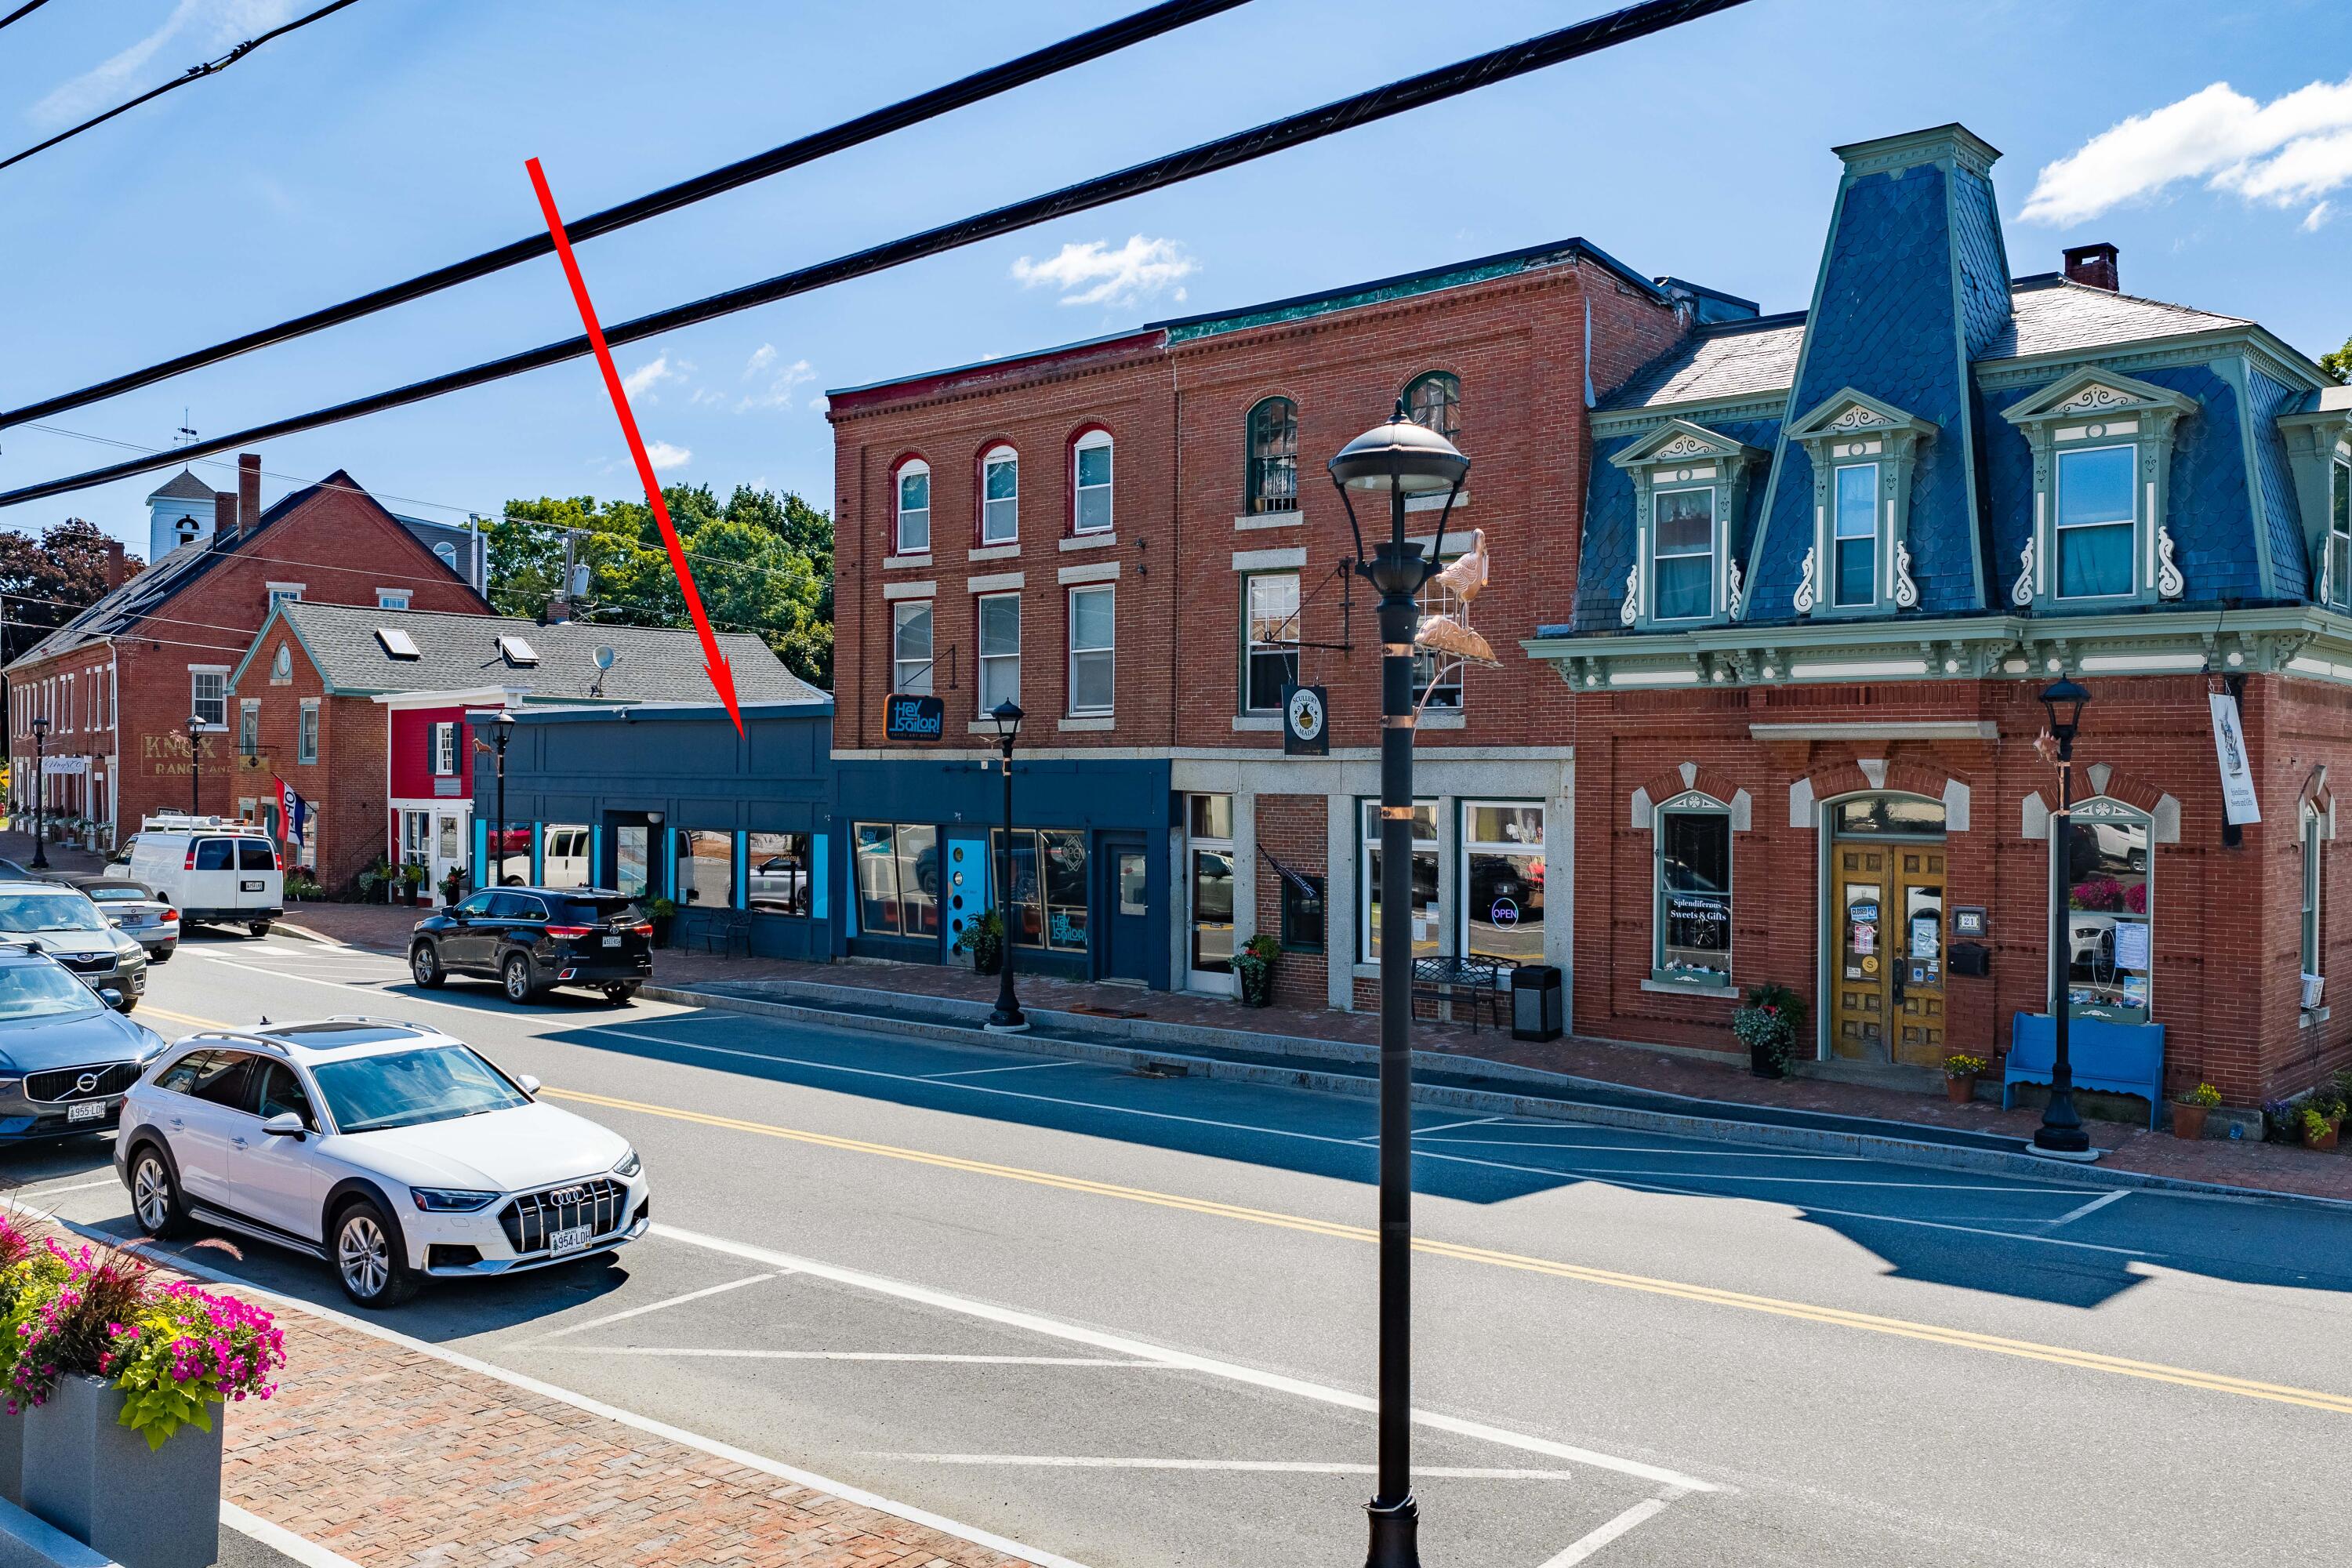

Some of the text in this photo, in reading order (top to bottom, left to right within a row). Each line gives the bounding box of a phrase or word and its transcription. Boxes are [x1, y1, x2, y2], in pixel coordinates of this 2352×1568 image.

[1292, 695, 1317, 704] SCULLERY
[1673, 898, 1722, 908] Splendiferous
[1494, 909, 1517, 918] OPEN
[1670, 909, 1726, 920] Sweets & Gifts
[1964, 917, 1974, 926] 21
